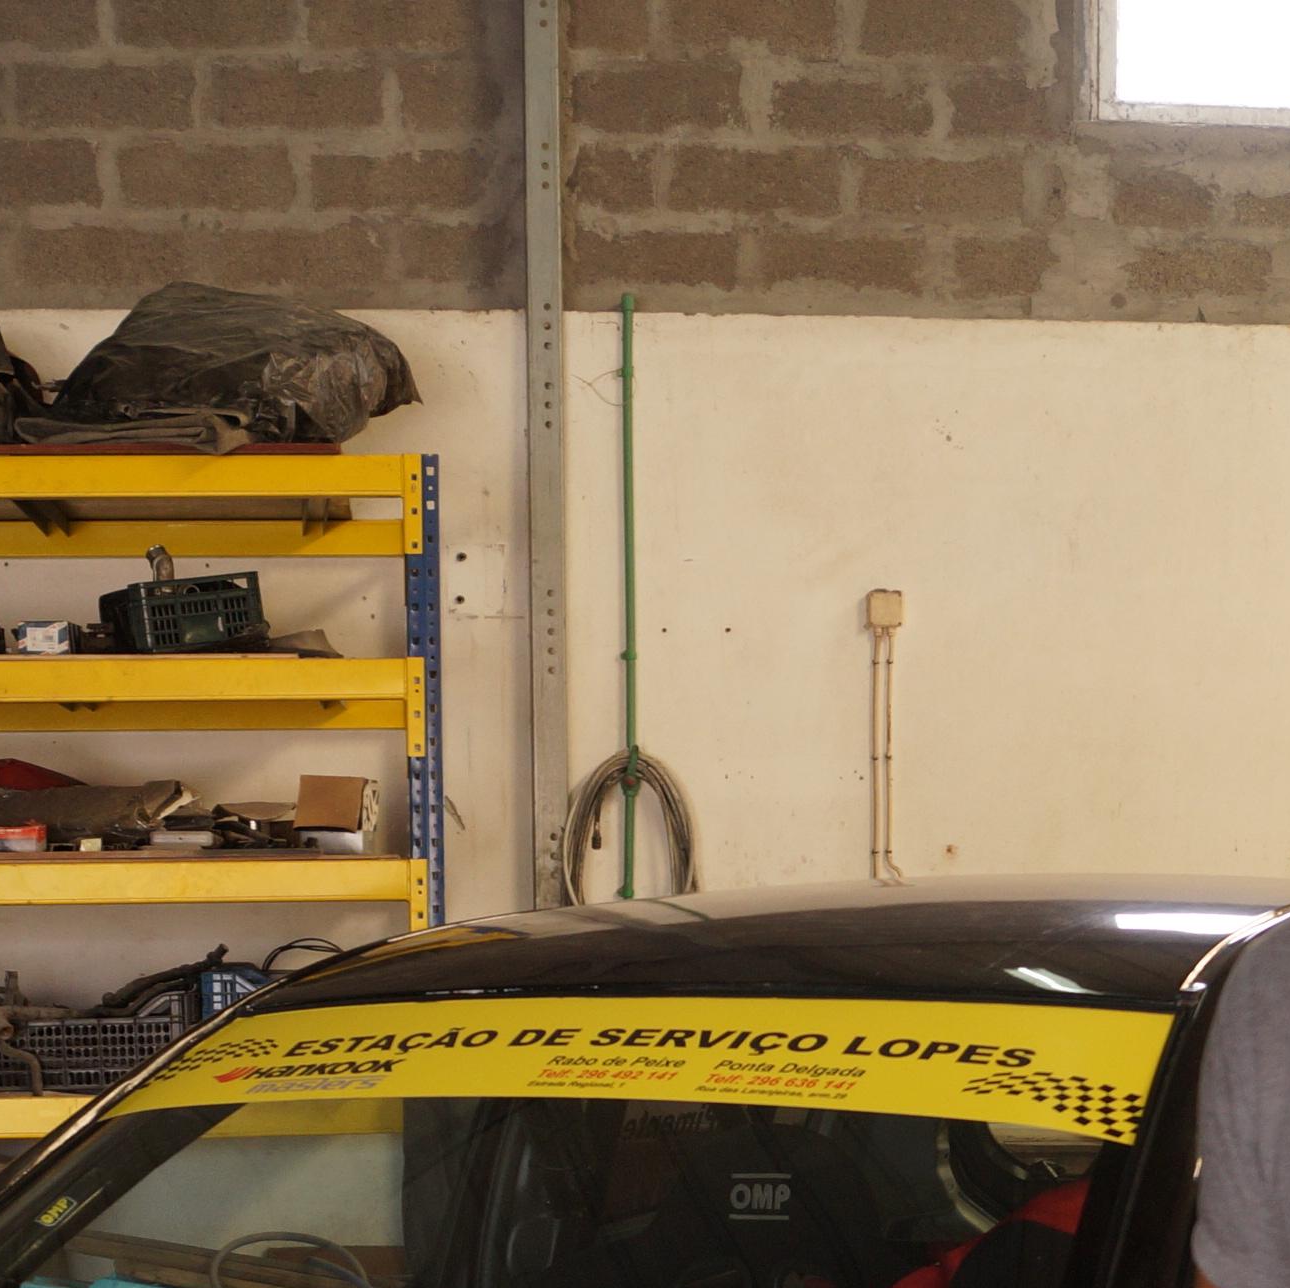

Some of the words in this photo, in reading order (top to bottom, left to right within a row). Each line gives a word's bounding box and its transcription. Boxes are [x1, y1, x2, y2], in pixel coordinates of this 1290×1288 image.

[283, 1026, 499, 1057] ESTAÇÃO
[508, 1028, 583, 1047] DE
[589, 1028, 829, 1057] SERVIÇO
[841, 1035, 1037, 1068] LOPES
[547, 1055, 599, 1067] Rabo
[602, 1056, 628, 1067] de
[629, 1056, 687, 1068] Peixe
[713, 1059, 776, 1073] Ponta
[778, 1061, 867, 1078] Delgada
[576, 1069, 608, 1080] 296
[611, 1070, 644, 1081] 492
[647, 1071, 679, 1082] 141
[746, 1075, 780, 1087] 296
[784, 1076, 820, 1089] 636
[824, 1078, 858, 1091] 141
[729, 1182, 792, 1211] OMP
[40, 1197, 68, 1224] OMP
